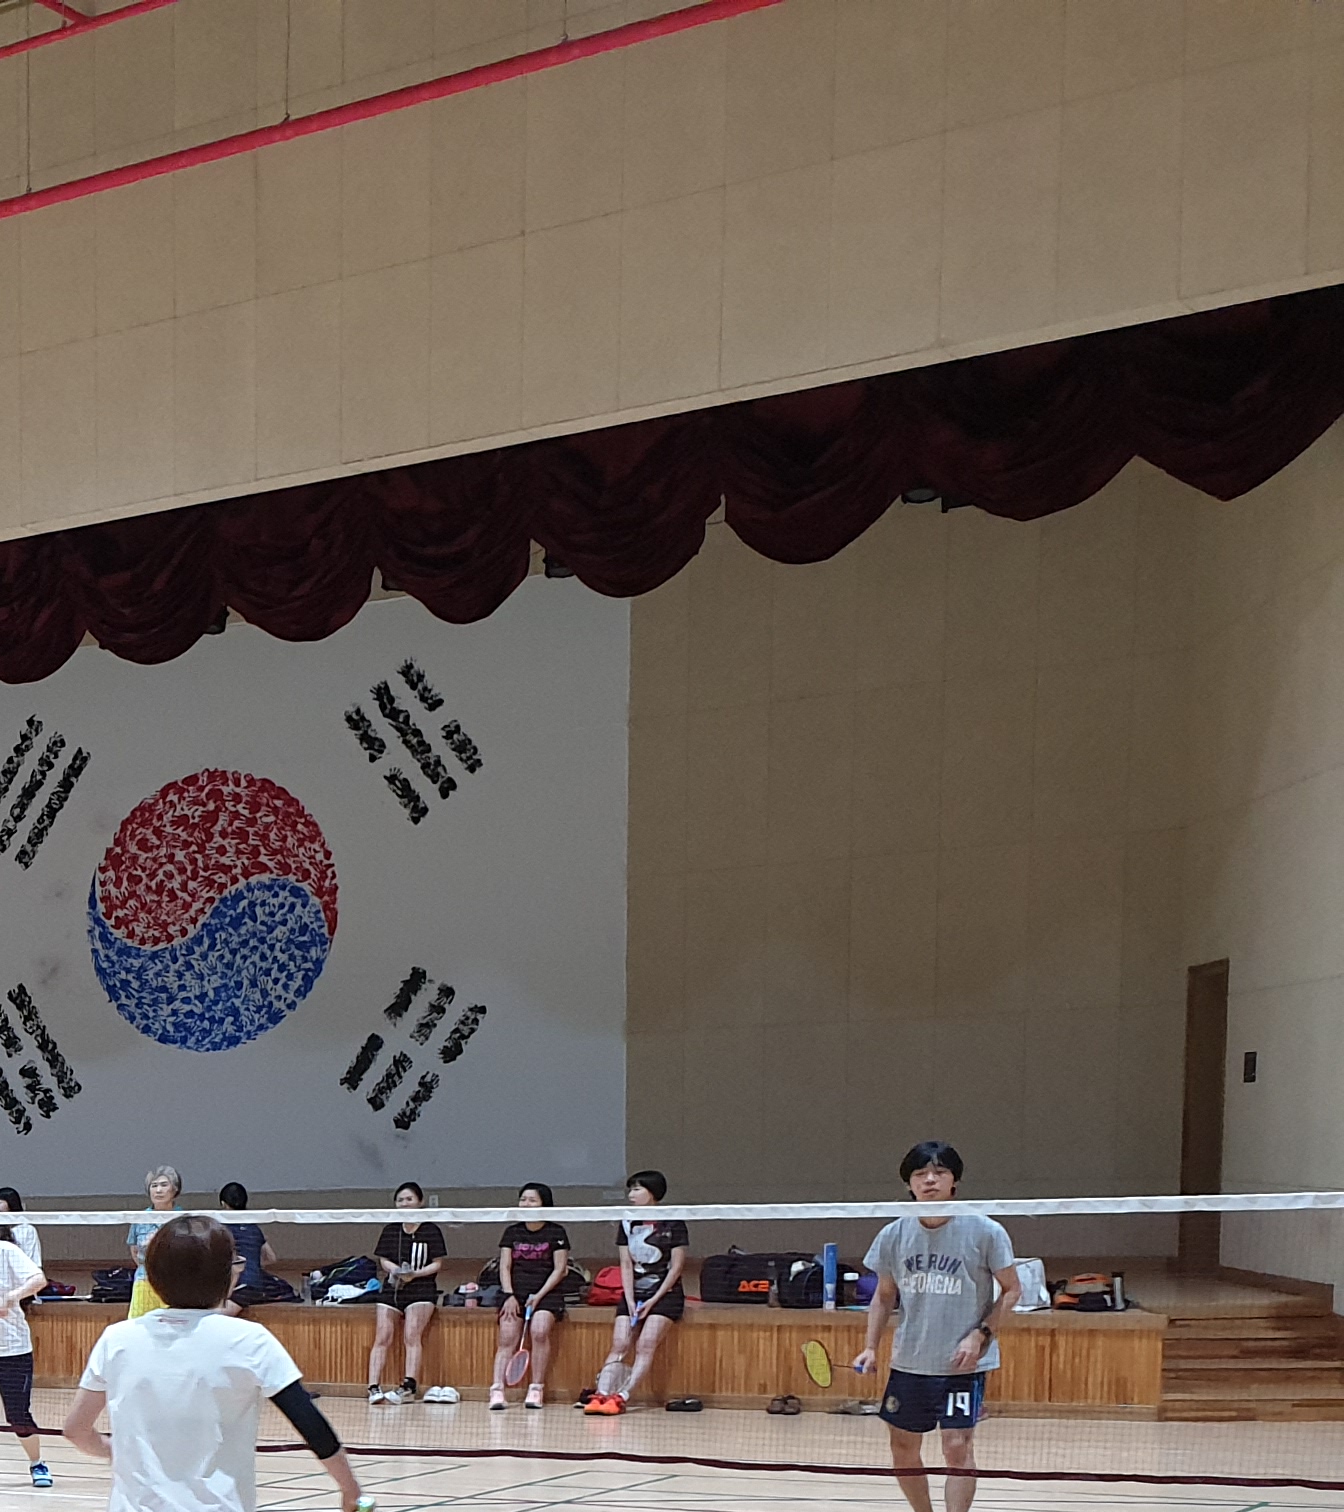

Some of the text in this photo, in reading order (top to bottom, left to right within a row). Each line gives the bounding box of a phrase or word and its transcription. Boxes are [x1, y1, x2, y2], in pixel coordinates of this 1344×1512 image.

[904, 1253, 962, 1275] WE RUN
[738, 1280, 770, 1292] ACE
[946, 1391, 971, 1416] 19
